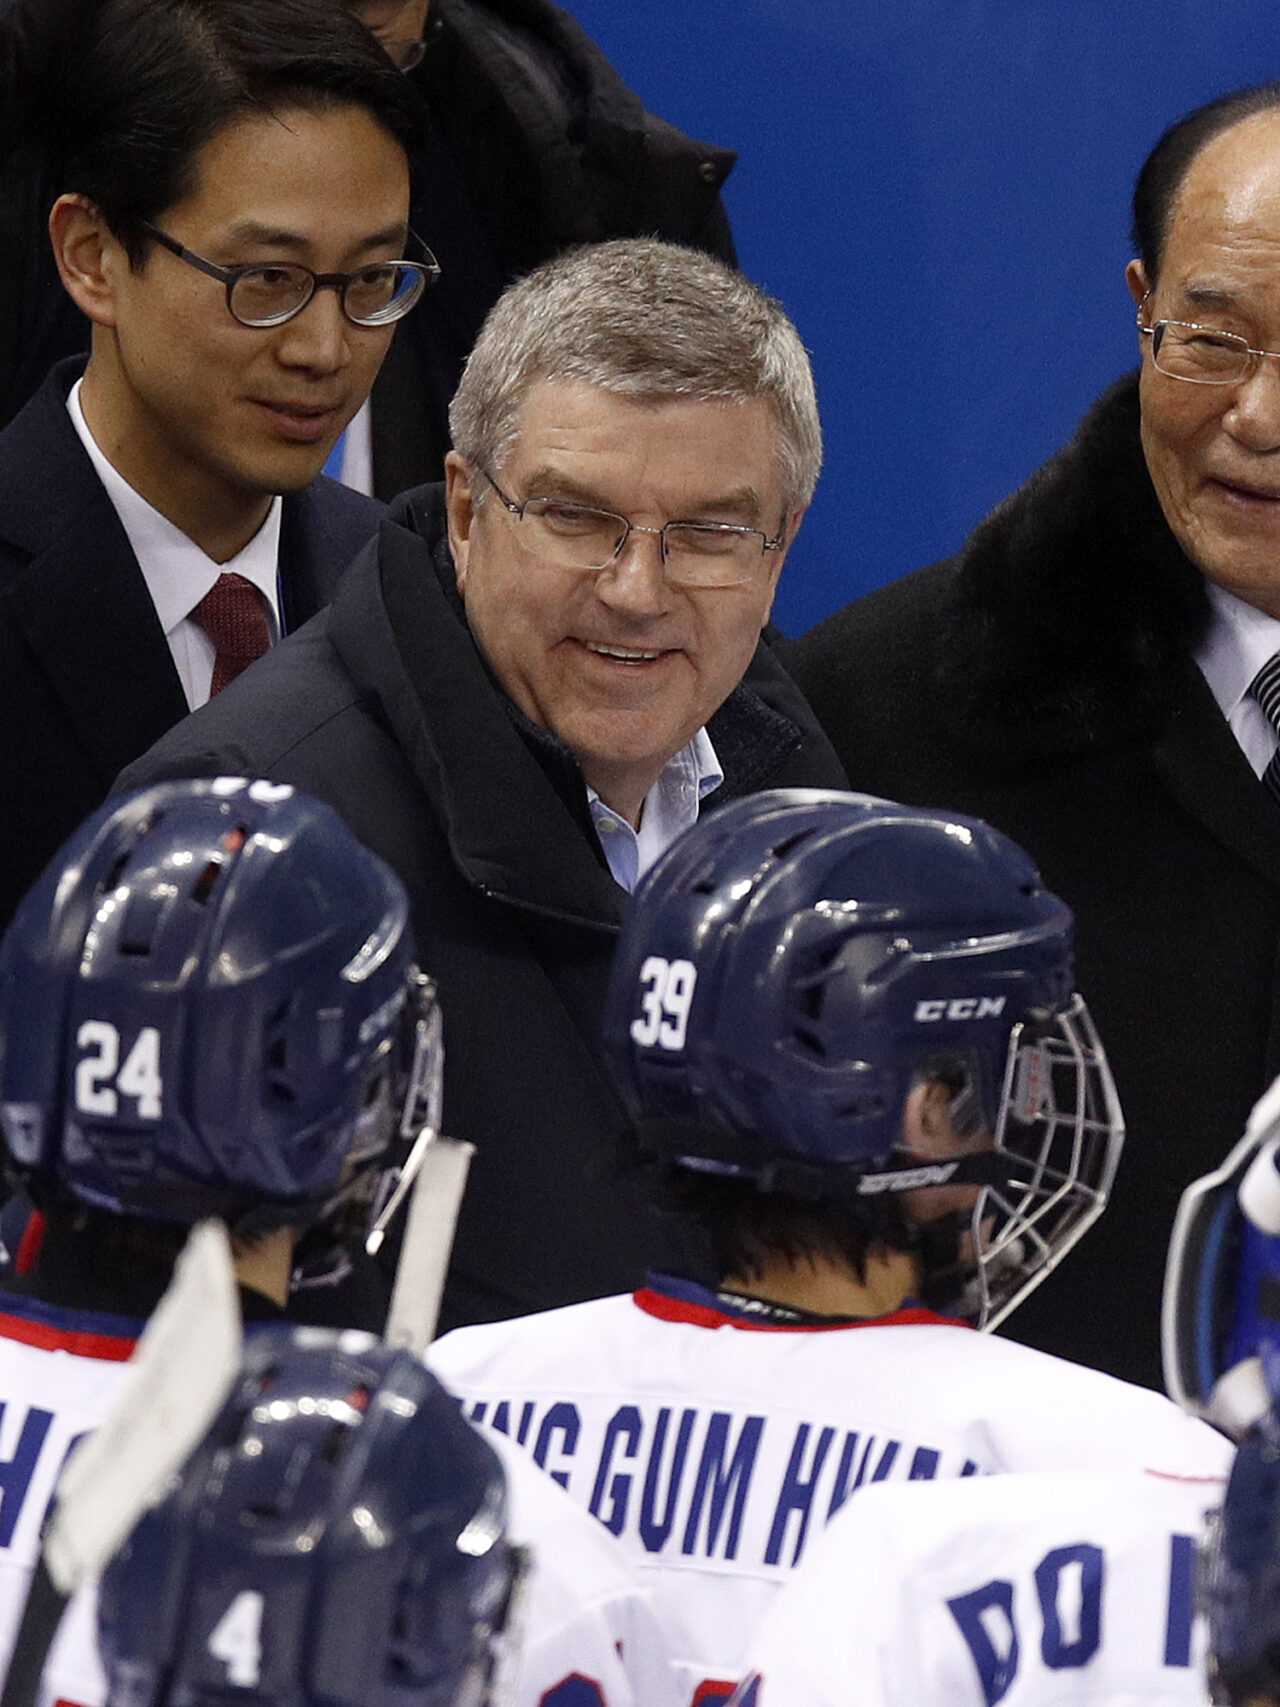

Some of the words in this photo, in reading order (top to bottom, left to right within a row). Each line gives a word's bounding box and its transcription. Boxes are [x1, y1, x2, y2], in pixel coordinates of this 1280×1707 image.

[629, 955, 698, 1050] 39
[914, 996, 1006, 1022] CCM
[75, 1020, 163, 1119] 24
[588, 1404, 766, 1563] GUM
[207, 1590, 264, 1688] 4
[946, 1543, 1105, 1707] DO
